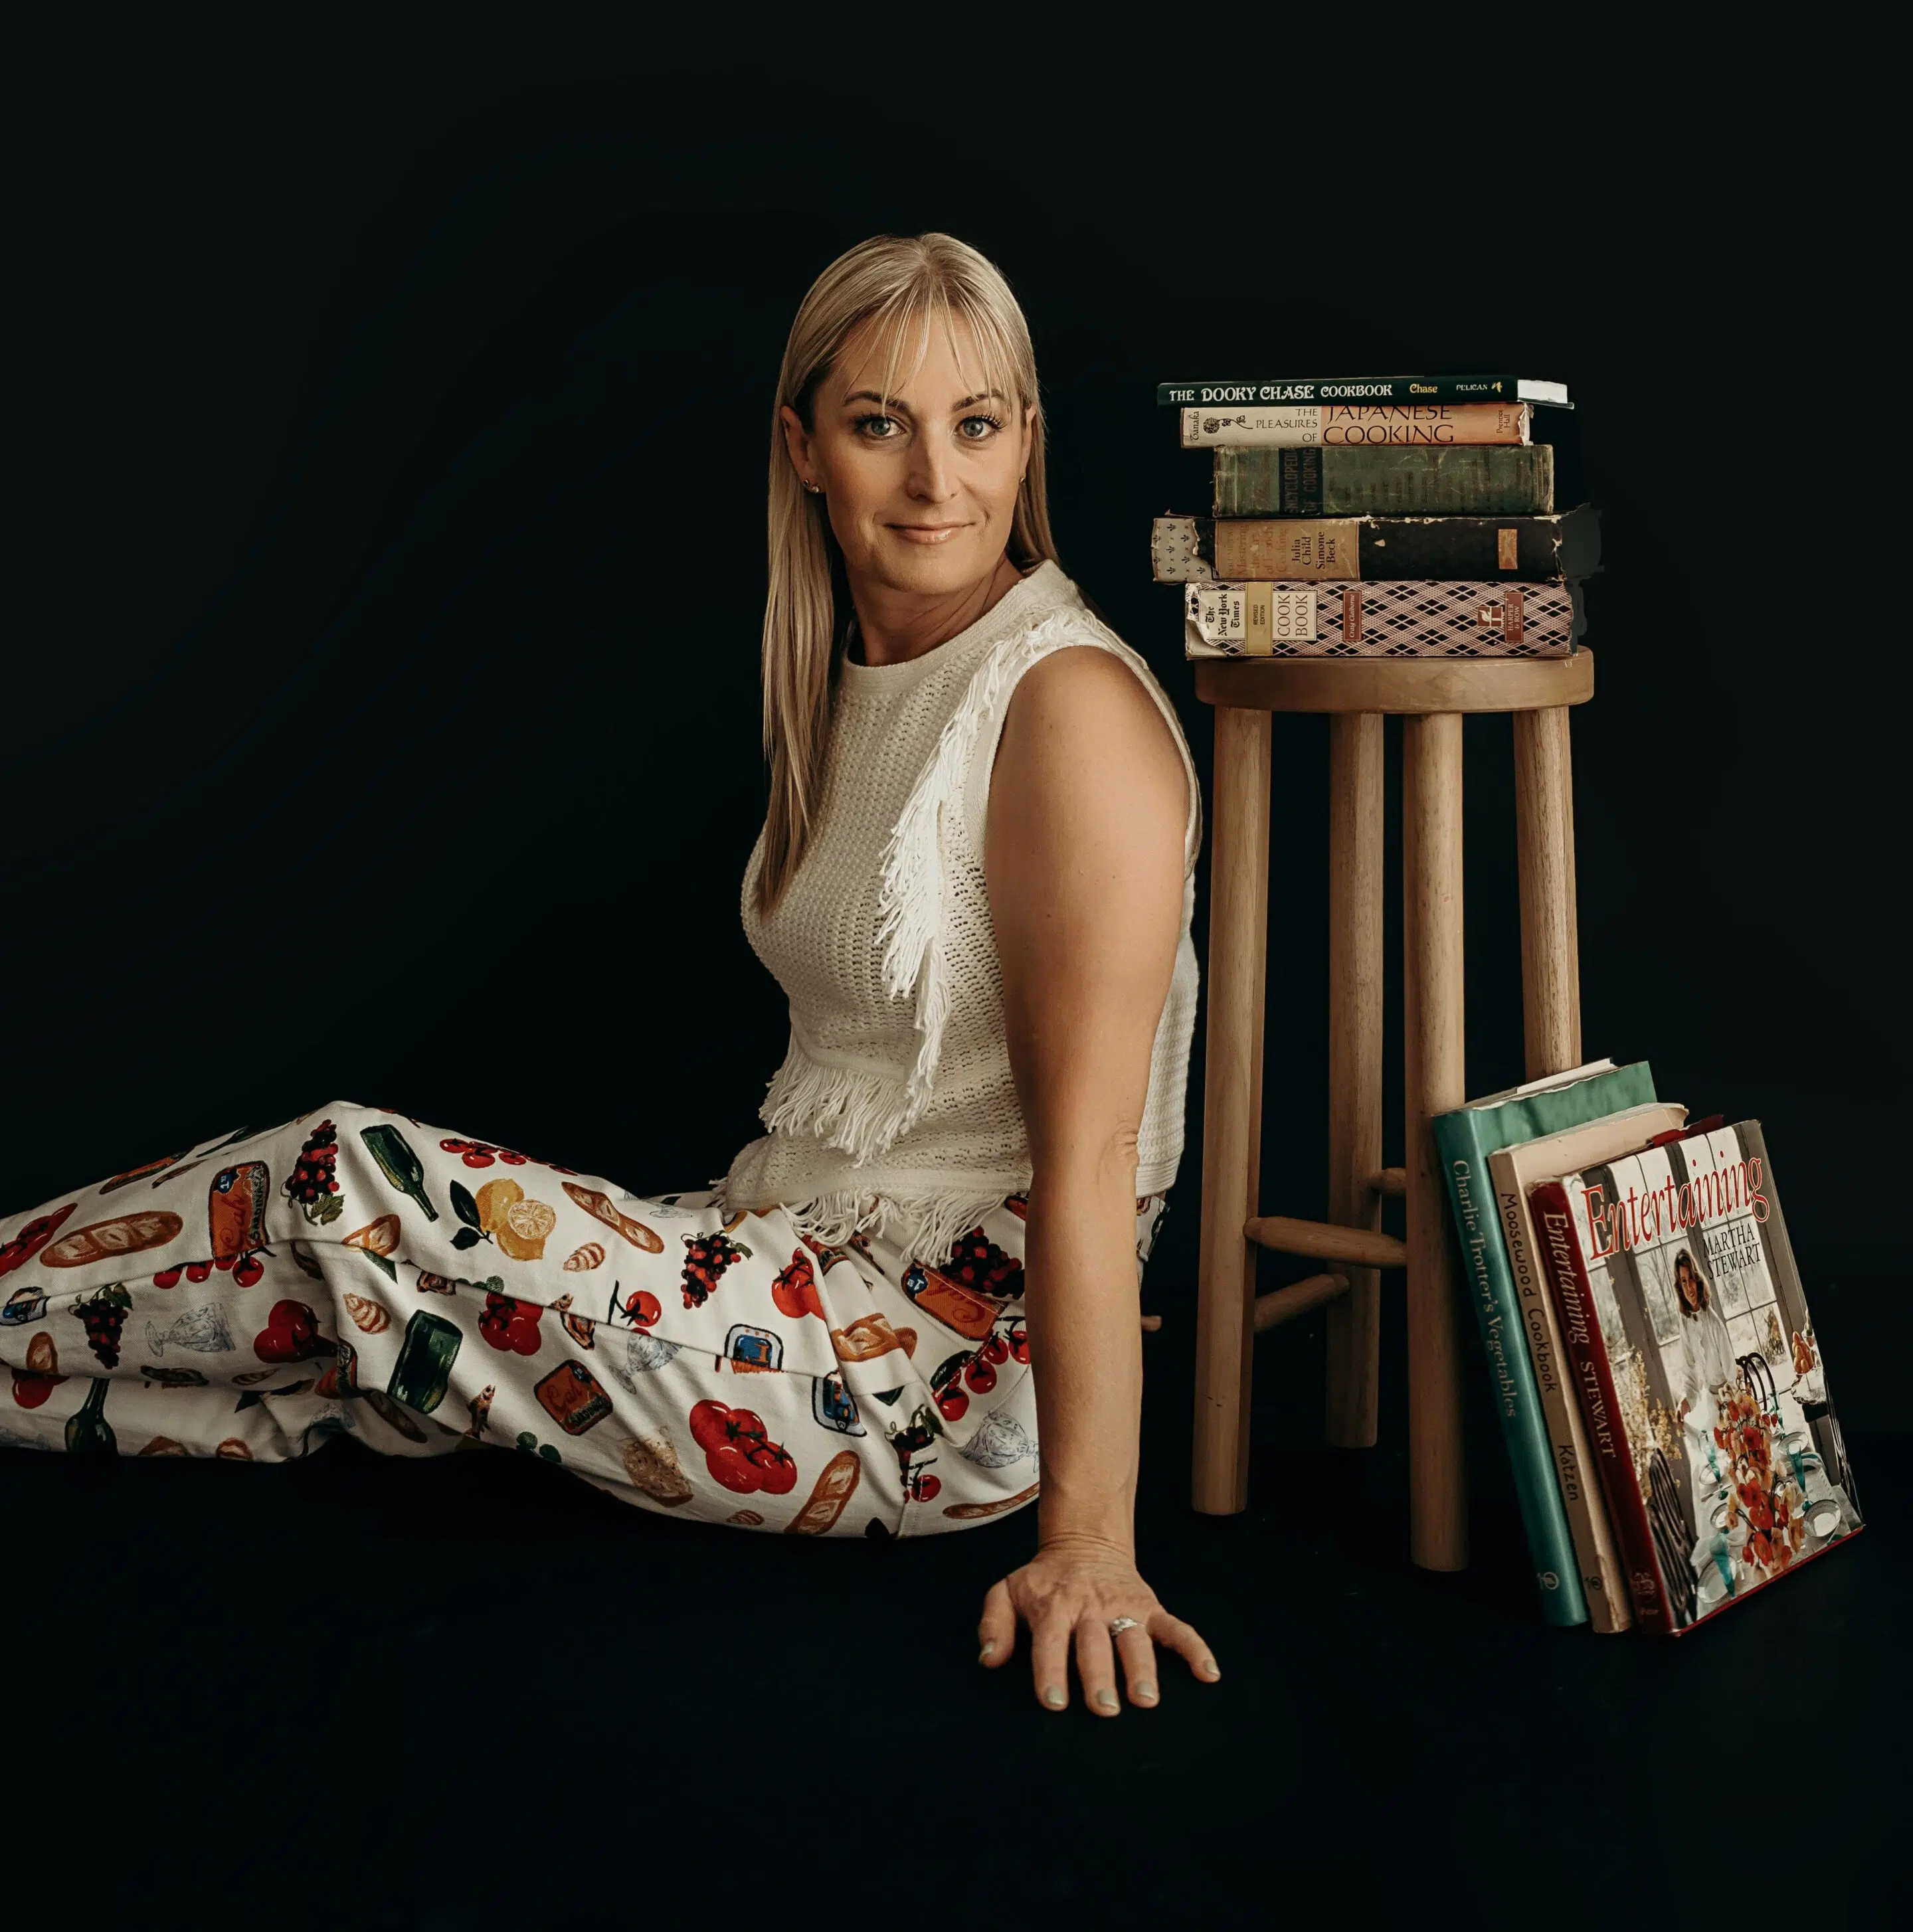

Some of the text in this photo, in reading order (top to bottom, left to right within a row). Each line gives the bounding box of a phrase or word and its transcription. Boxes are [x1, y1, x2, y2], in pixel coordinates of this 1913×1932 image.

[1169, 385, 1392, 402] THE DOOKY CHASE COOKBOOK
[1410, 384, 1437, 393] Chase
[1189, 411, 1200, 441] Tanaka
[1256, 419, 1318, 429] PLEASURES
[1327, 403, 1453, 423] JAPANESE
[1302, 434, 1317, 442] OF
[1323, 425, 1454, 445] COOKING
[1303, 448, 1317, 492] COOKING
[1236, 525, 1249, 576] Mastering
[1291, 539, 1301, 563] Julia
[1301, 536, 1311, 565] Child
[1315, 531, 1325, 569] Simone
[1326, 538, 1336, 563] Beck
[1205, 606, 1215, 623] The
[1218, 593, 1230, 636] New York
[1231, 600, 1240, 628] Times
[1277, 594, 1291, 636] COOK
[1295, 594, 1308, 636] BOOK
[1581, 1150, 1770, 1261] Entertaining
[1702, 1223, 1755, 1258] MARTHA
[1543, 1211, 1590, 1344] Entertaining
[1707, 1243, 1761, 1280] STEWART
[1453, 1160, 1479, 1231] Charlie
[1487, 1316, 1518, 1417] Vegetables
[1501, 1193, 1557, 1393] Moosewood Cookbook
[1580, 1361, 1617, 1458] STEWART
[1558, 1445, 1579, 1501] Katzen
